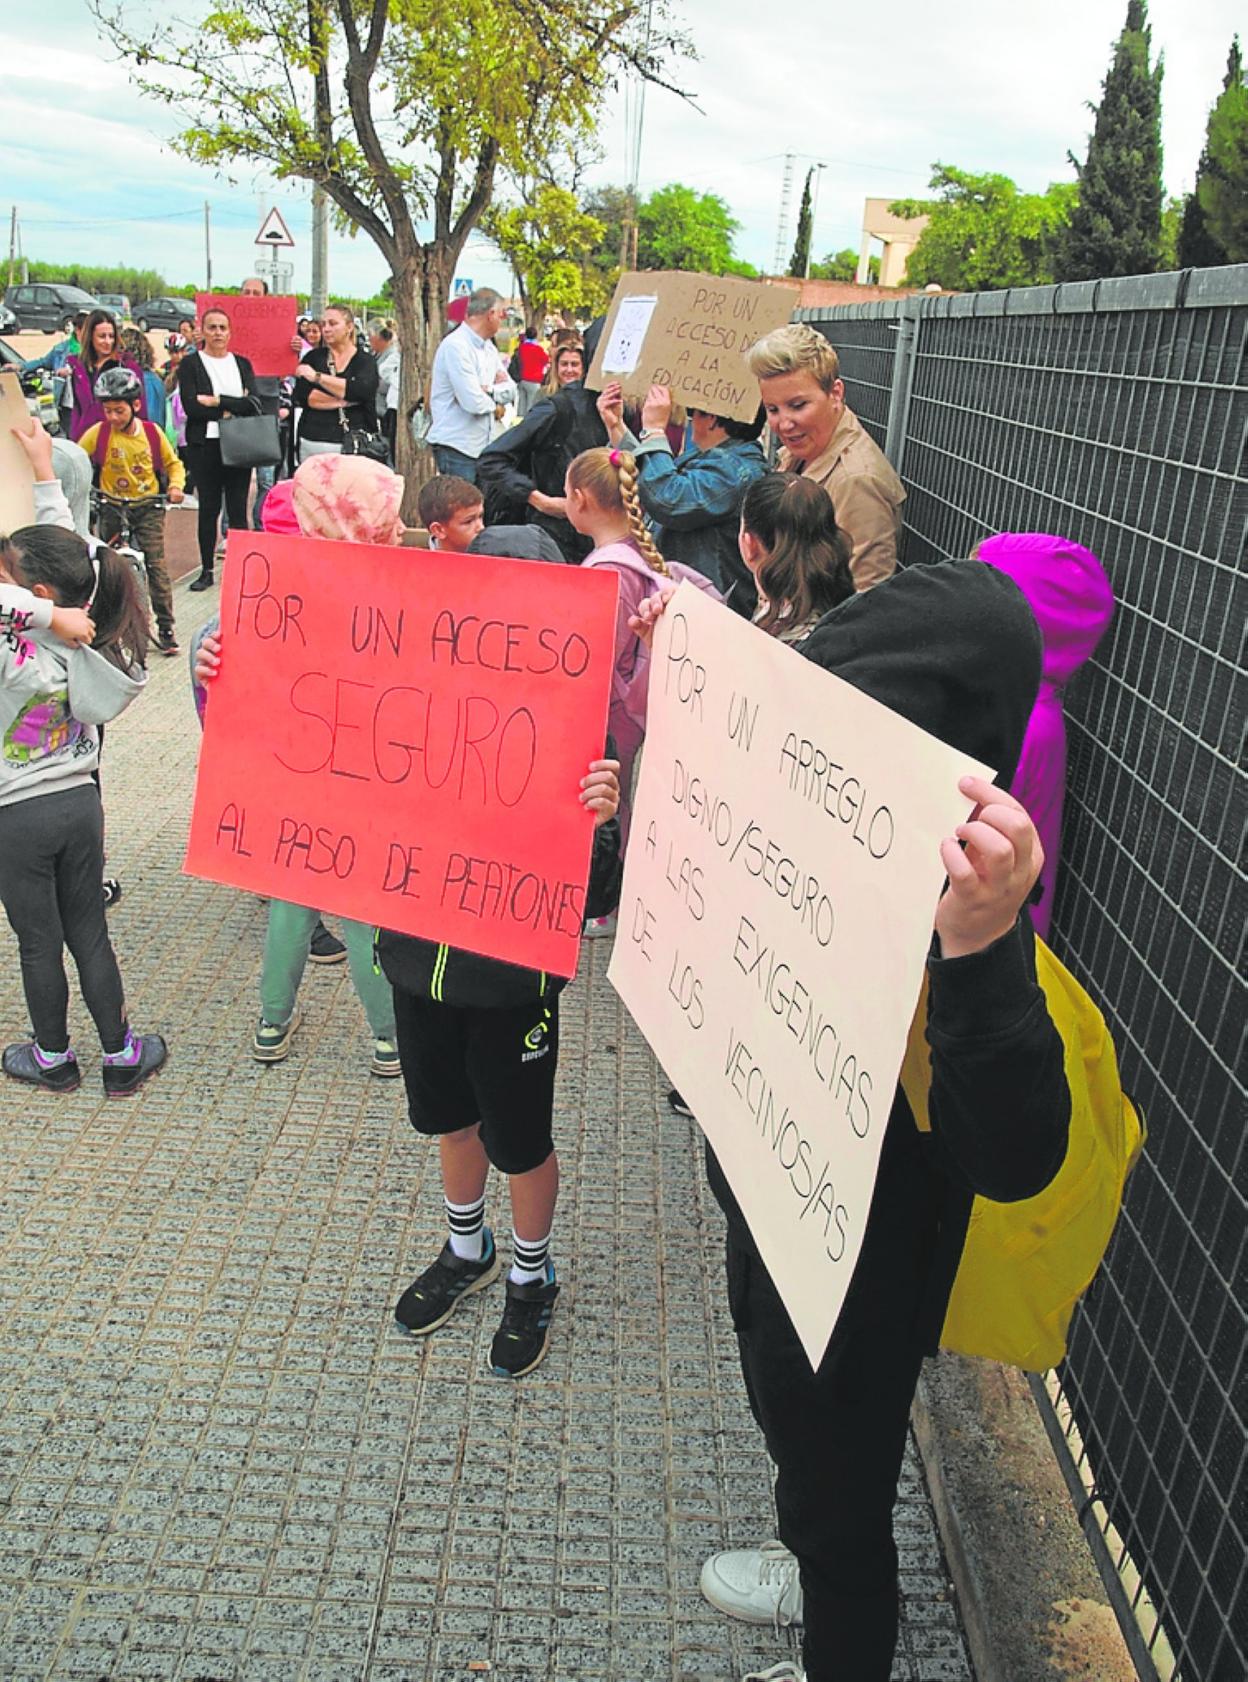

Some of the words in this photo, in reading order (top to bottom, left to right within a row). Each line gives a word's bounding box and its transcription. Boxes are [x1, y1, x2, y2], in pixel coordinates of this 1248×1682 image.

[665, 316, 737, 350] ACCESO
[676, 350, 691, 367] A
[698, 355, 721, 373] LA
[692, 288, 727, 315] POR
[732, 296, 760, 321] UN
[235, 551, 307, 647] POR
[350, 605, 405, 658] UN
[431, 609, 592, 679] ACCESO
[273, 670, 538, 808] SEGURO
[663, 612, 707, 723] POR
[726, 692, 760, 753] UN
[778, 732, 895, 860] ARREGLO
[215, 802, 253, 858] AL
[273, 817, 357, 880] PASO
[382, 842, 423, 900] DE
[440, 852, 587, 939] PEATONES
[671, 759, 834, 947] DIGNO/SEGURO
[644, 819, 658, 861] A
[665, 840, 706, 922] LAS
[732, 915, 873, 1139] EXIGENCIAS
[631, 896, 658, 963] DE
[667, 948, 706, 1030] LOS
[724, 1026, 850, 1263] VECINOS/AS
